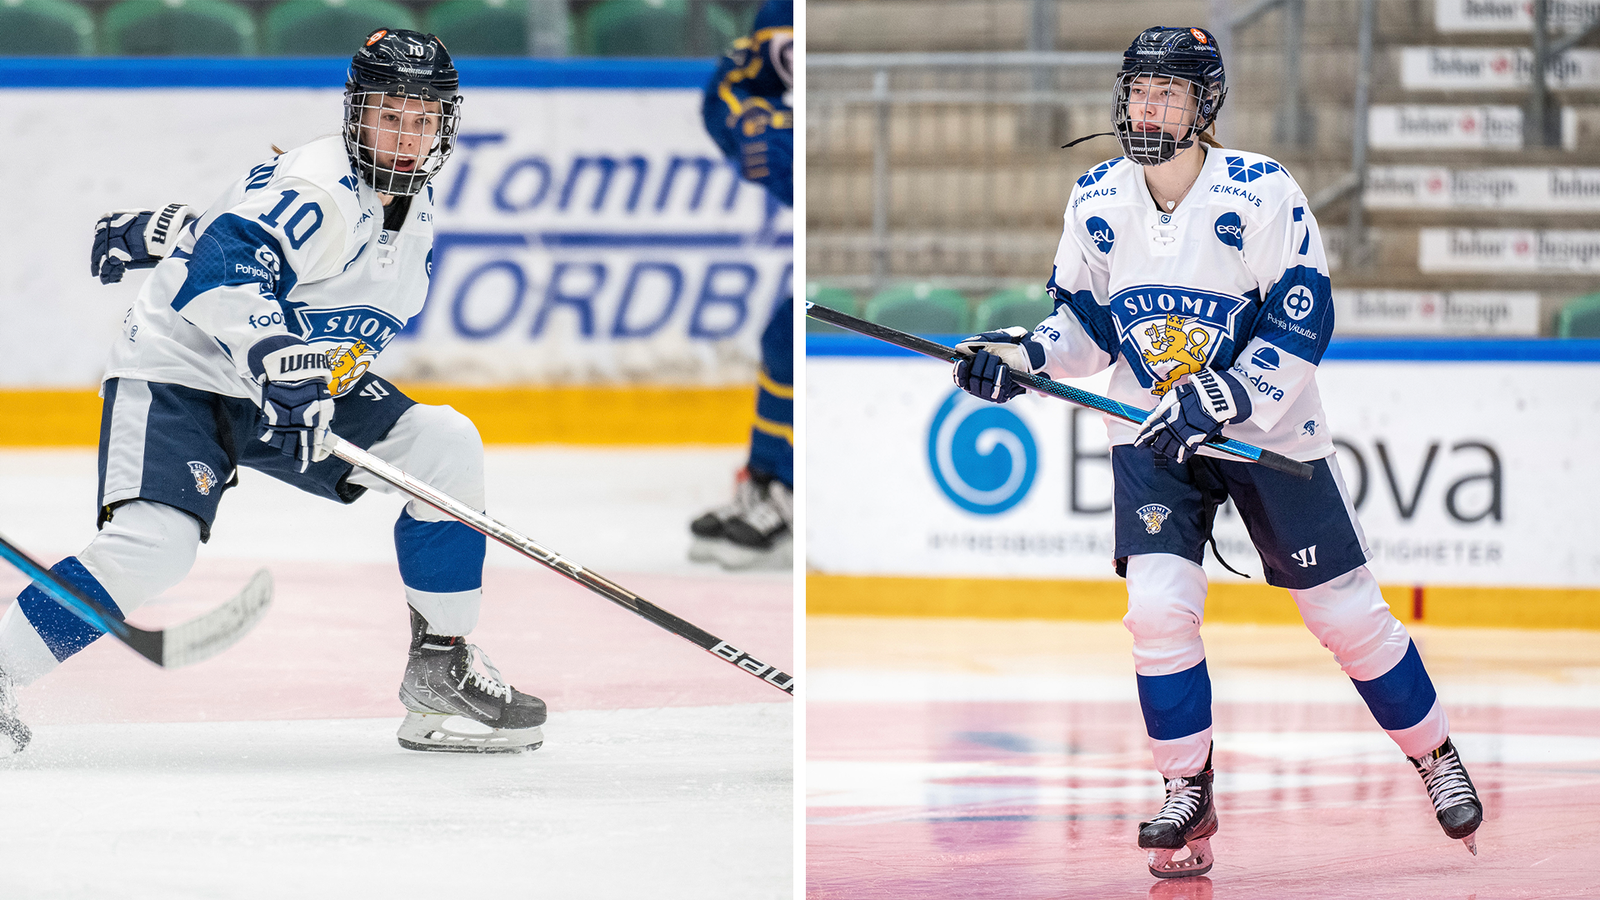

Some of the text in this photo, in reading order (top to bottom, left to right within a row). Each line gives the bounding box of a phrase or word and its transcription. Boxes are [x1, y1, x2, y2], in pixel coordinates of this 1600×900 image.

[445, 130, 778, 240] Tomm
[1071, 187, 1117, 208] EIKKAUS
[257, 189, 325, 250] 10
[235, 263, 269, 280] Pohjola
[1123, 293, 1218, 318] SUOMI
[248, 311, 287, 329] foo
[323, 314, 397, 349] SUOM
[1141, 505, 1166, 514] SUOMI
